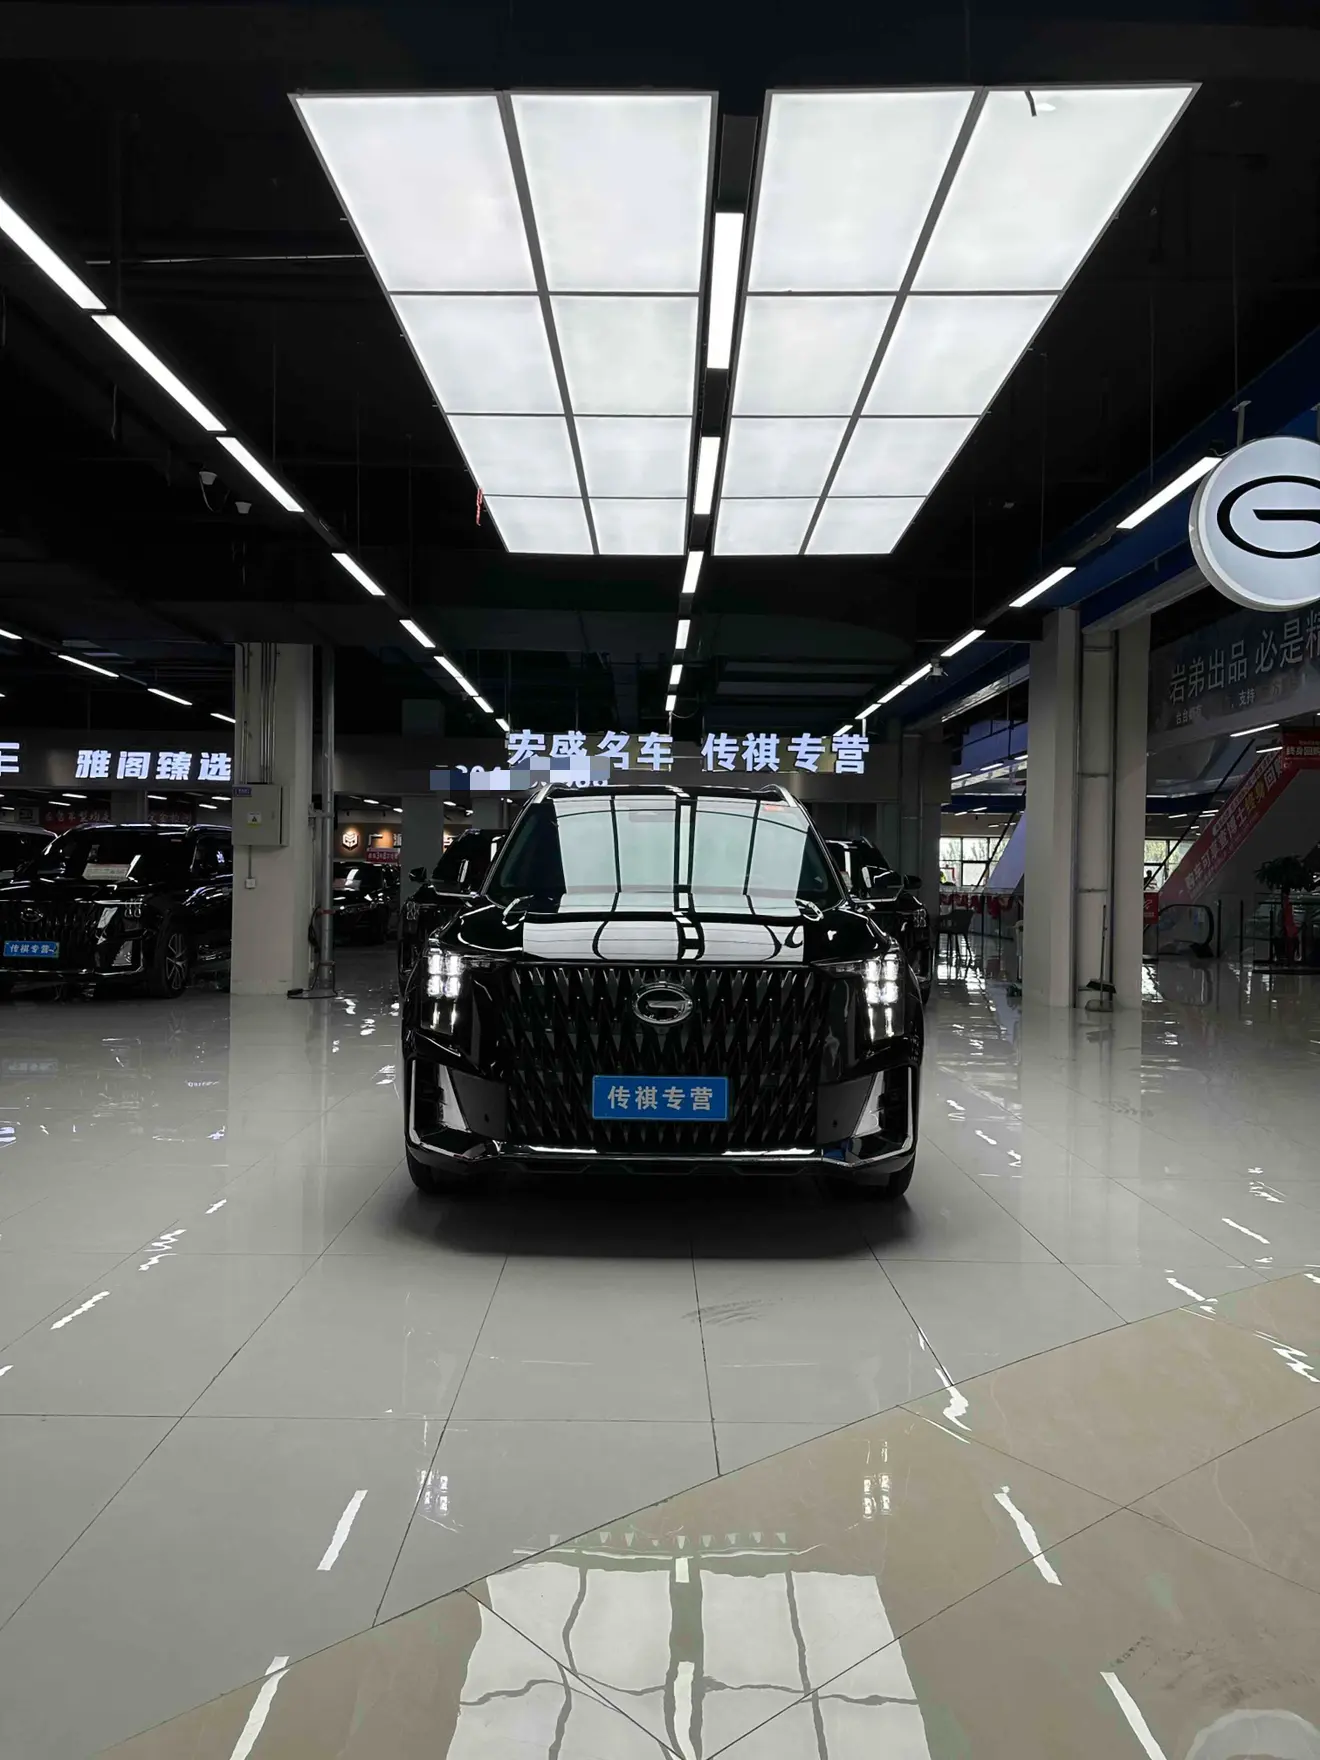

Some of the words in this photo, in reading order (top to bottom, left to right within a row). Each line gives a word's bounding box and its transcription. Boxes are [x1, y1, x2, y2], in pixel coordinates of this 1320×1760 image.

[1169, 639, 1248, 705] 岩弟出品
[75, 749, 232, 781] 雅阁臻选
[701, 732, 870, 774] 传祺专营
[607, 1085, 713, 1111] 传祺专营
